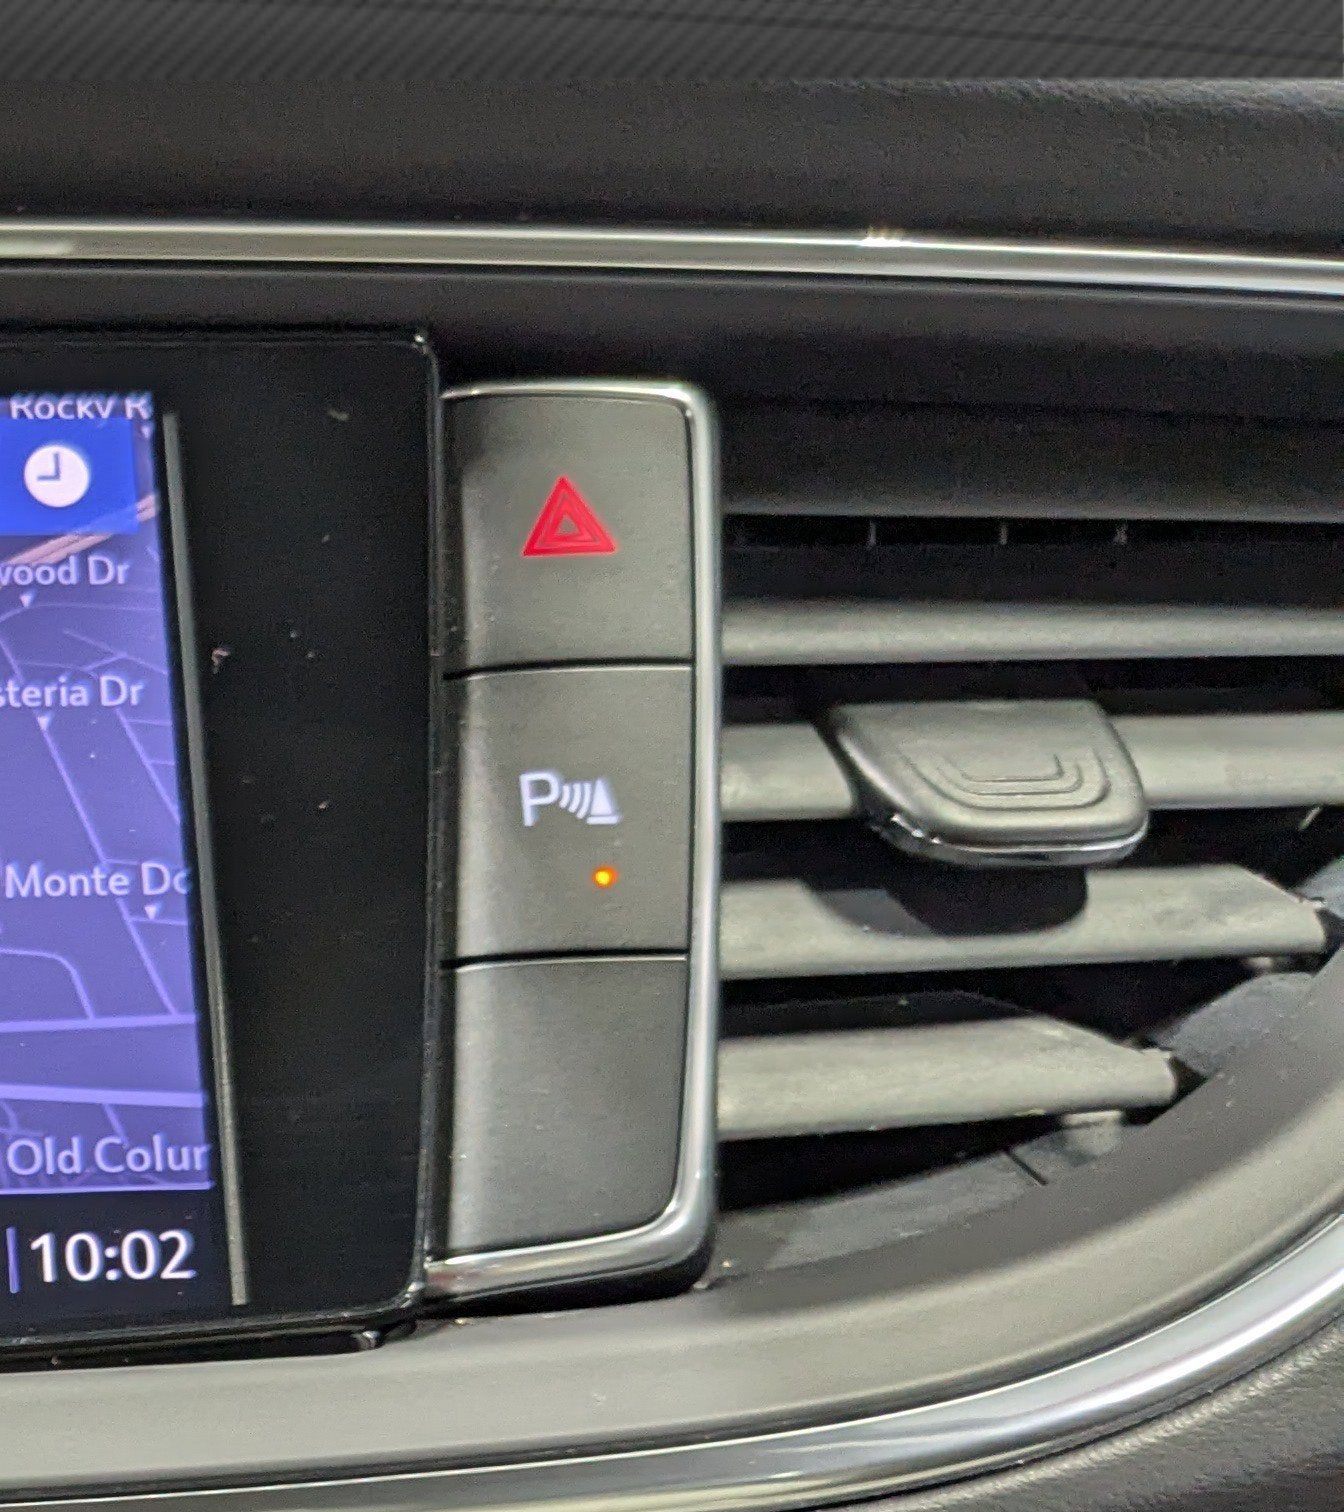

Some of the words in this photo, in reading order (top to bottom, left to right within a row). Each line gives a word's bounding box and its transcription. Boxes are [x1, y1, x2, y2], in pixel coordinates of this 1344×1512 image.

[85, 556, 129, 587] Dr
[99, 677, 145, 707] Dr
[5, 863, 130, 898] Monte
[6, 1135, 82, 1176] Old
[30, 1229, 196, 1284] 10:02
